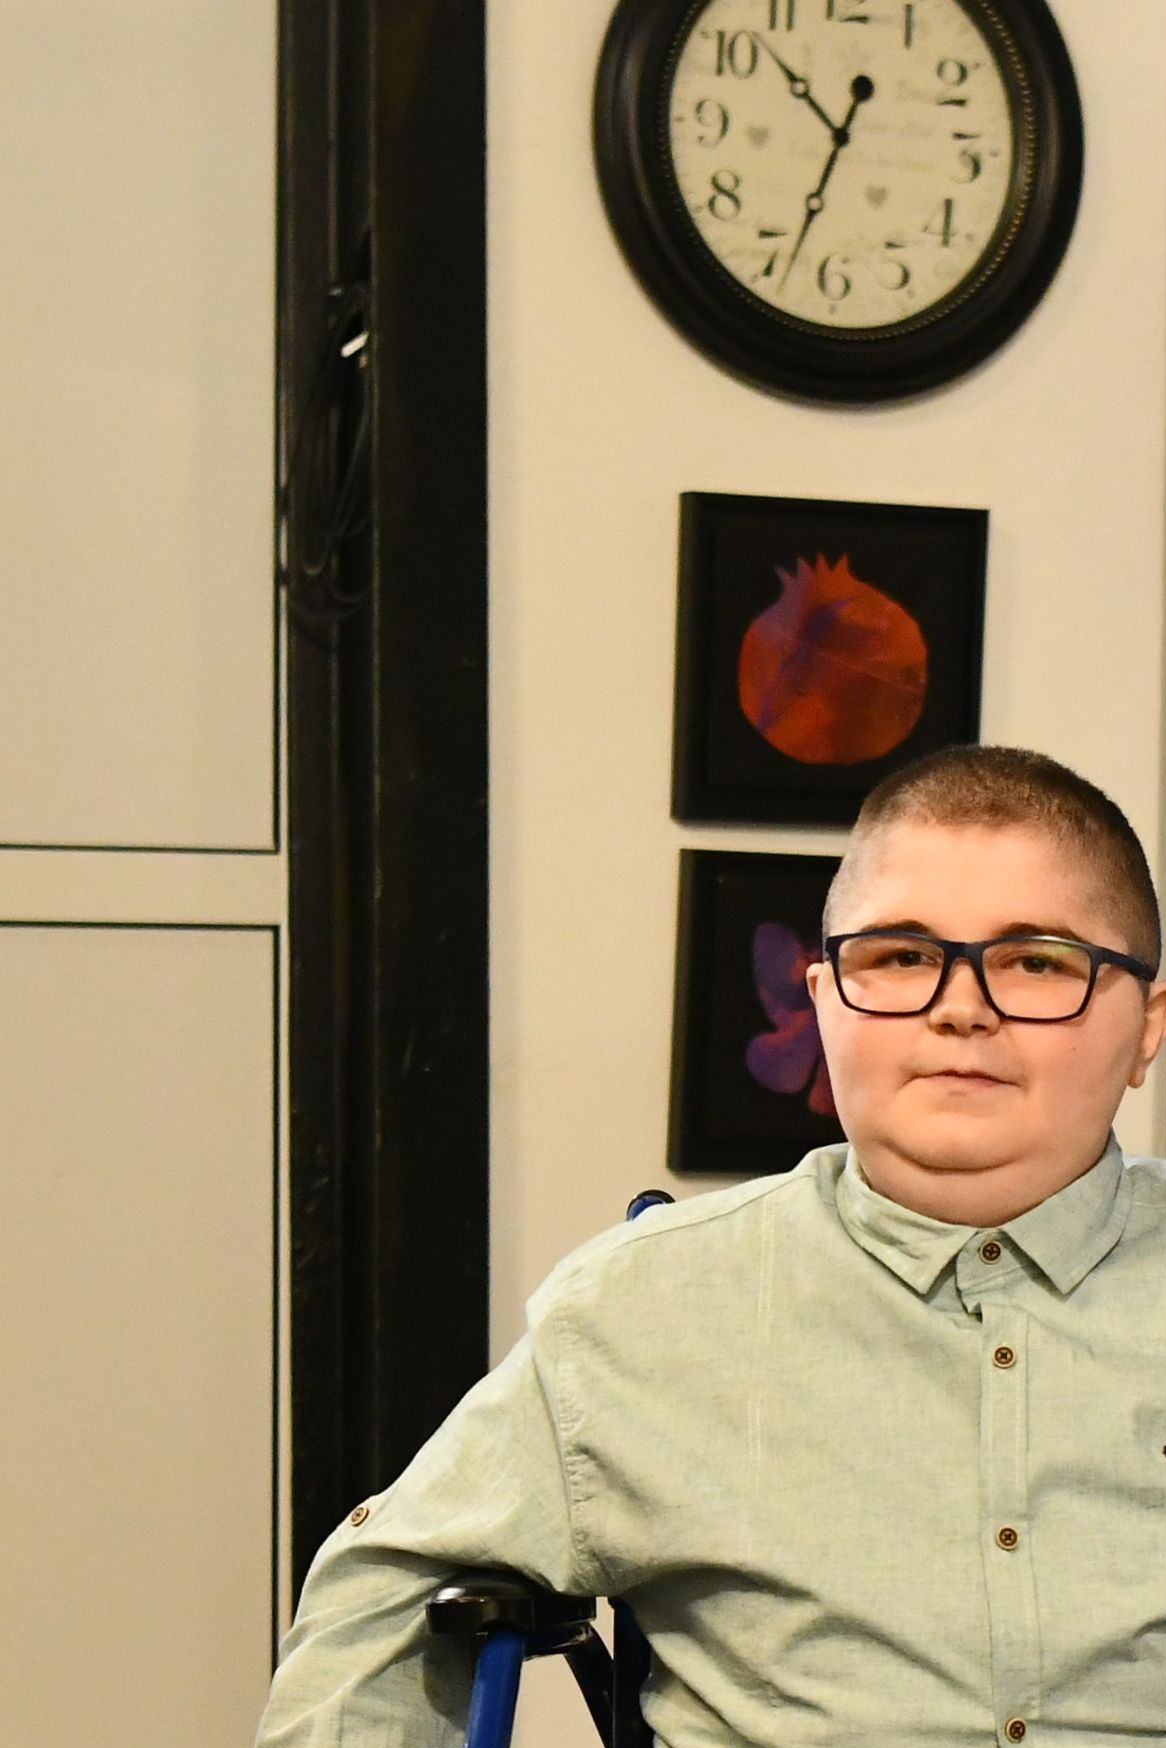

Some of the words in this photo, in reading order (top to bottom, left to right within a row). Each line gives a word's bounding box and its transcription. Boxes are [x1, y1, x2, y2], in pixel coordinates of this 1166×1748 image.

[904, 3, 914, 49] 1
[711, 30, 759, 79] 10
[937, 58, 969, 107] 2
[695, 100, 729, 147] 9
[708, 170, 742, 220] 8
[922, 198, 957, 247] 4
[753, 229, 788, 282] 7
[817, 253, 851, 301] 6
[880, 241, 910, 291] 5
